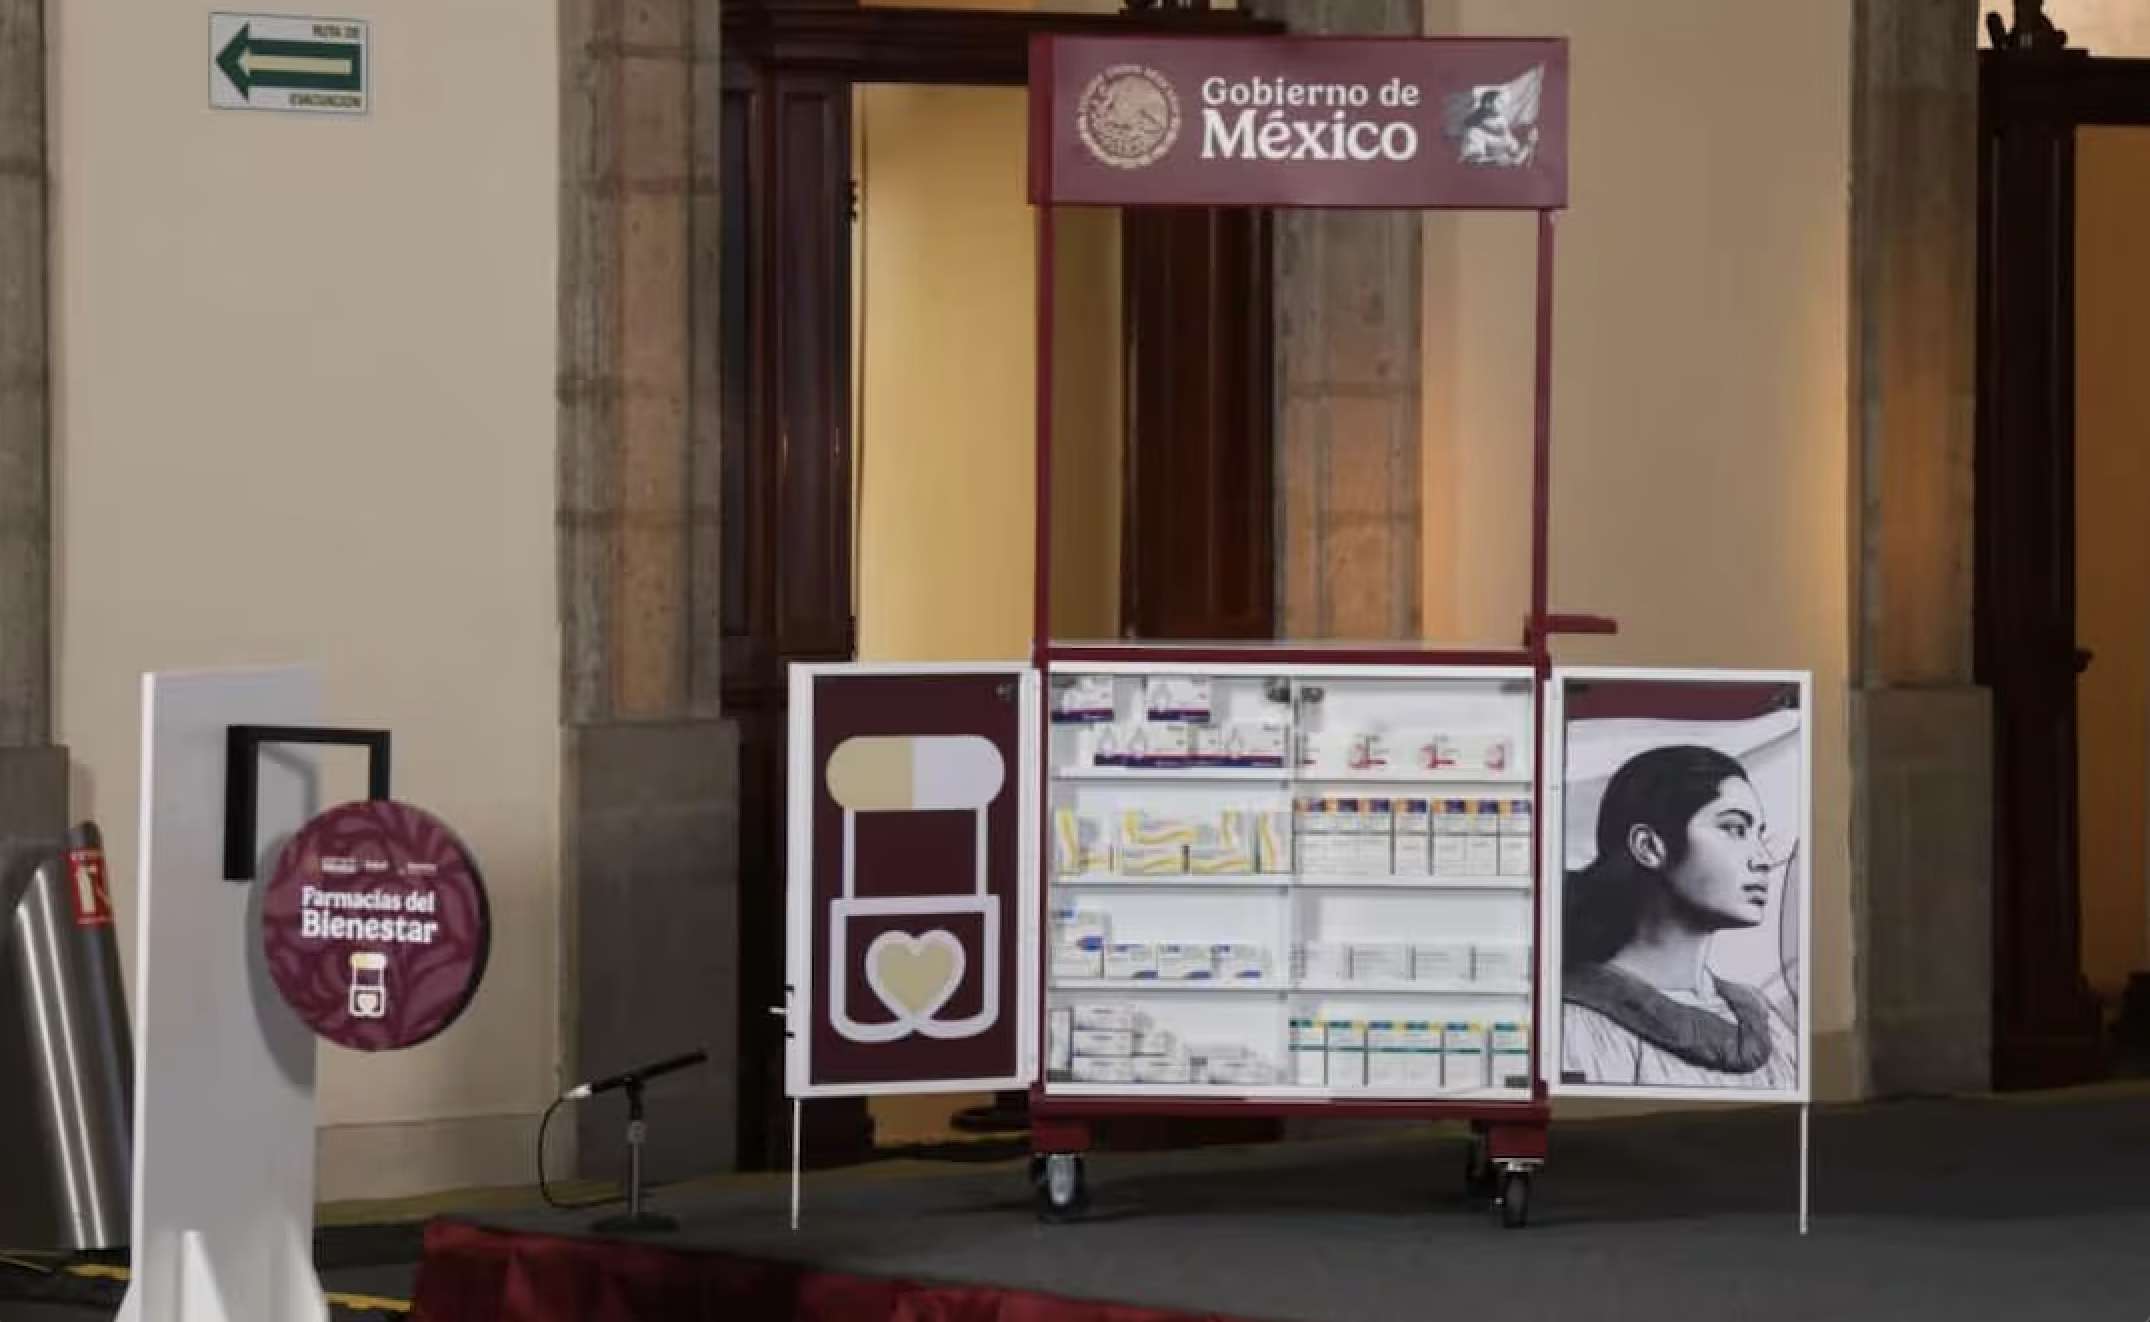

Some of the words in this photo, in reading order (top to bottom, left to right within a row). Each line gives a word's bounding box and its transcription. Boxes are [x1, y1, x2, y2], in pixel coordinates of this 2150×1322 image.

[1201, 76, 1368, 106] Gobierno
[1378, 78, 1420, 107] de
[1200, 109, 1418, 161] México
[302, 886, 401, 911] Farmacias
[405, 890, 435, 913] del
[302, 909, 439, 943] Bienestar
